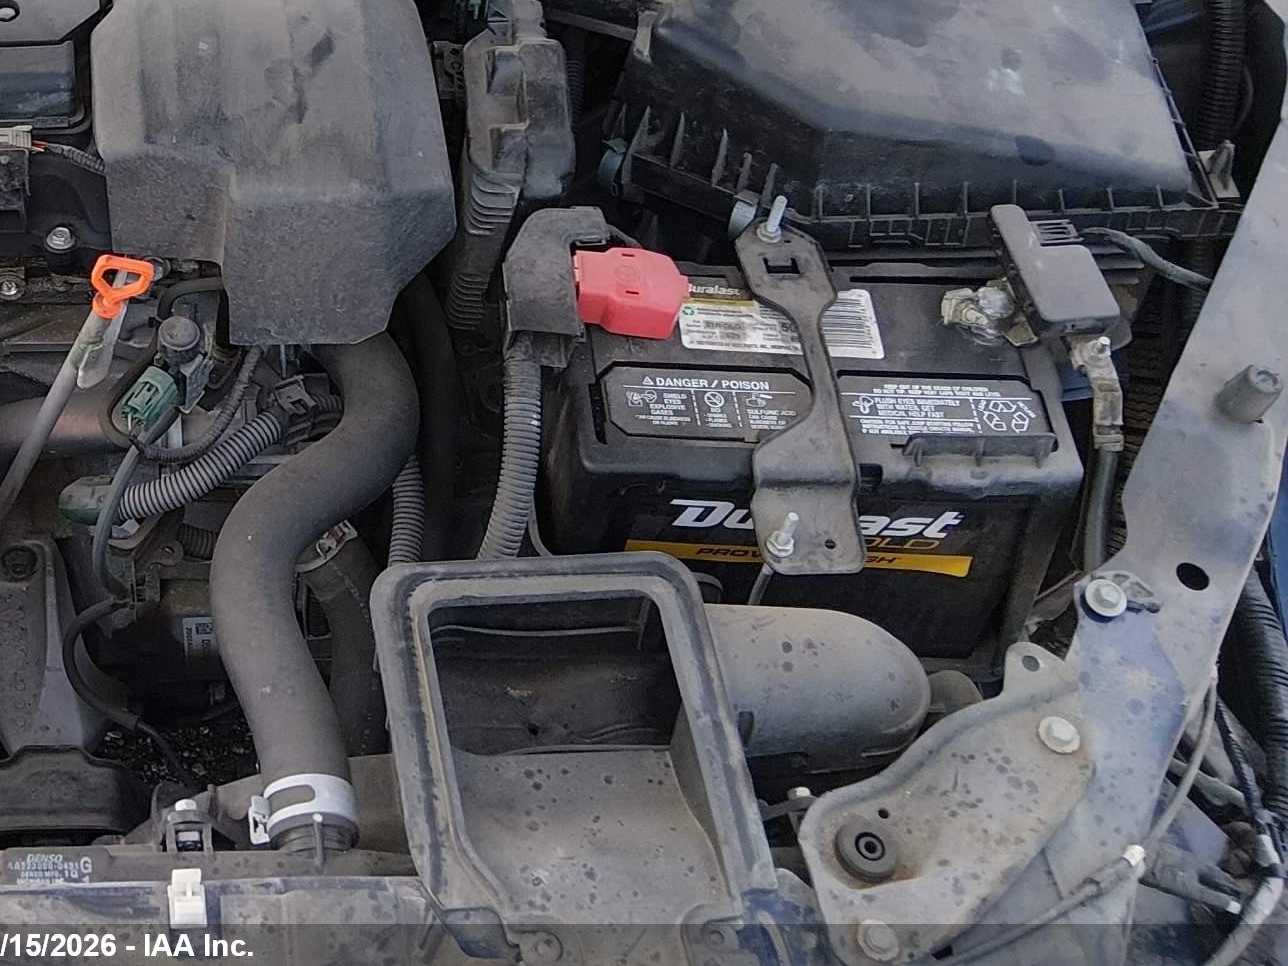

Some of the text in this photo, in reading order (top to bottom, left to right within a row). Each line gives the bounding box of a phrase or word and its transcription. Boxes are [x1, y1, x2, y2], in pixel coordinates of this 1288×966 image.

[655, 377, 708, 388] DANGER
[721, 380, 770, 391] POISON
[26, 853, 64, 863] DENSO
